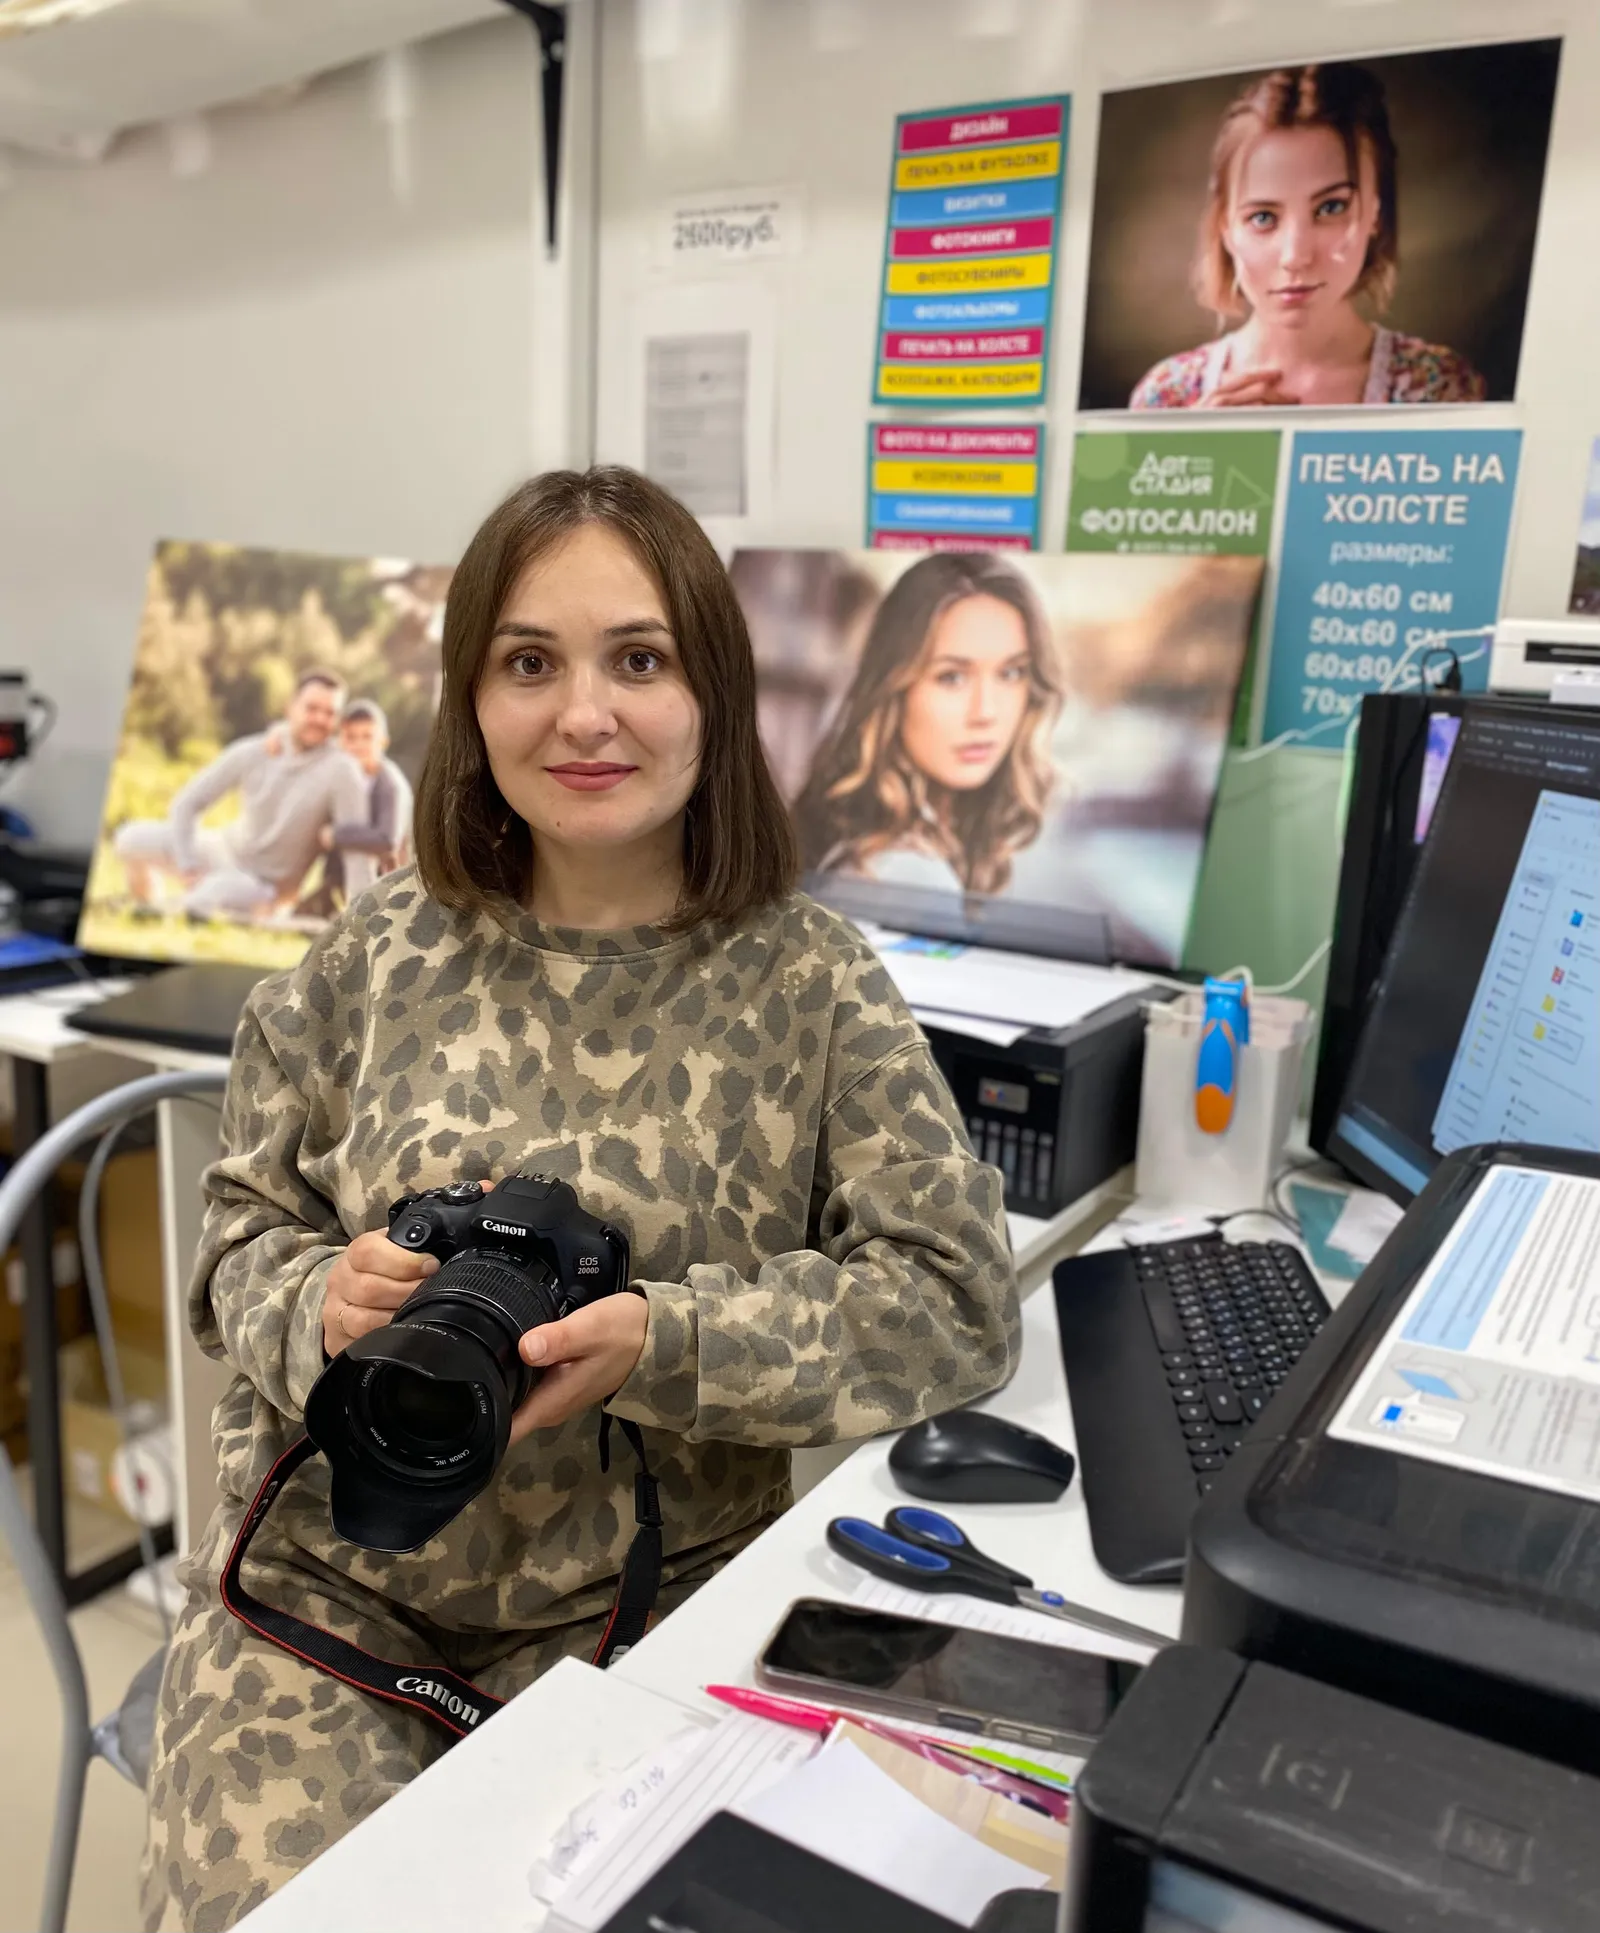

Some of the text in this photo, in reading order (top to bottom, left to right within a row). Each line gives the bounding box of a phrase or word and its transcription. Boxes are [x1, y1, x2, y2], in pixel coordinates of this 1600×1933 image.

[882, 430, 924, 448] ФОТО
[1298, 453, 1505, 484] ПЕЧАТЬ НА
[1322, 493, 1469, 524] ХОЛСТЕ
[1080, 506, 1258, 536] ФОТОСАЛОН
[1329, 541, 1454, 568] размеры:
[1408, 590, 1453, 613] см
[481, 1218, 527, 1238] Canon
[577, 1266, 600, 1275] 2000D
[579, 1256, 599, 1266] EOS
[361, 1367, 375, 1388] CANON
[479, 1400, 488, 1415] USM
[448, 1448, 470, 1463] CANON
[395, 1676, 481, 1726] Canon
